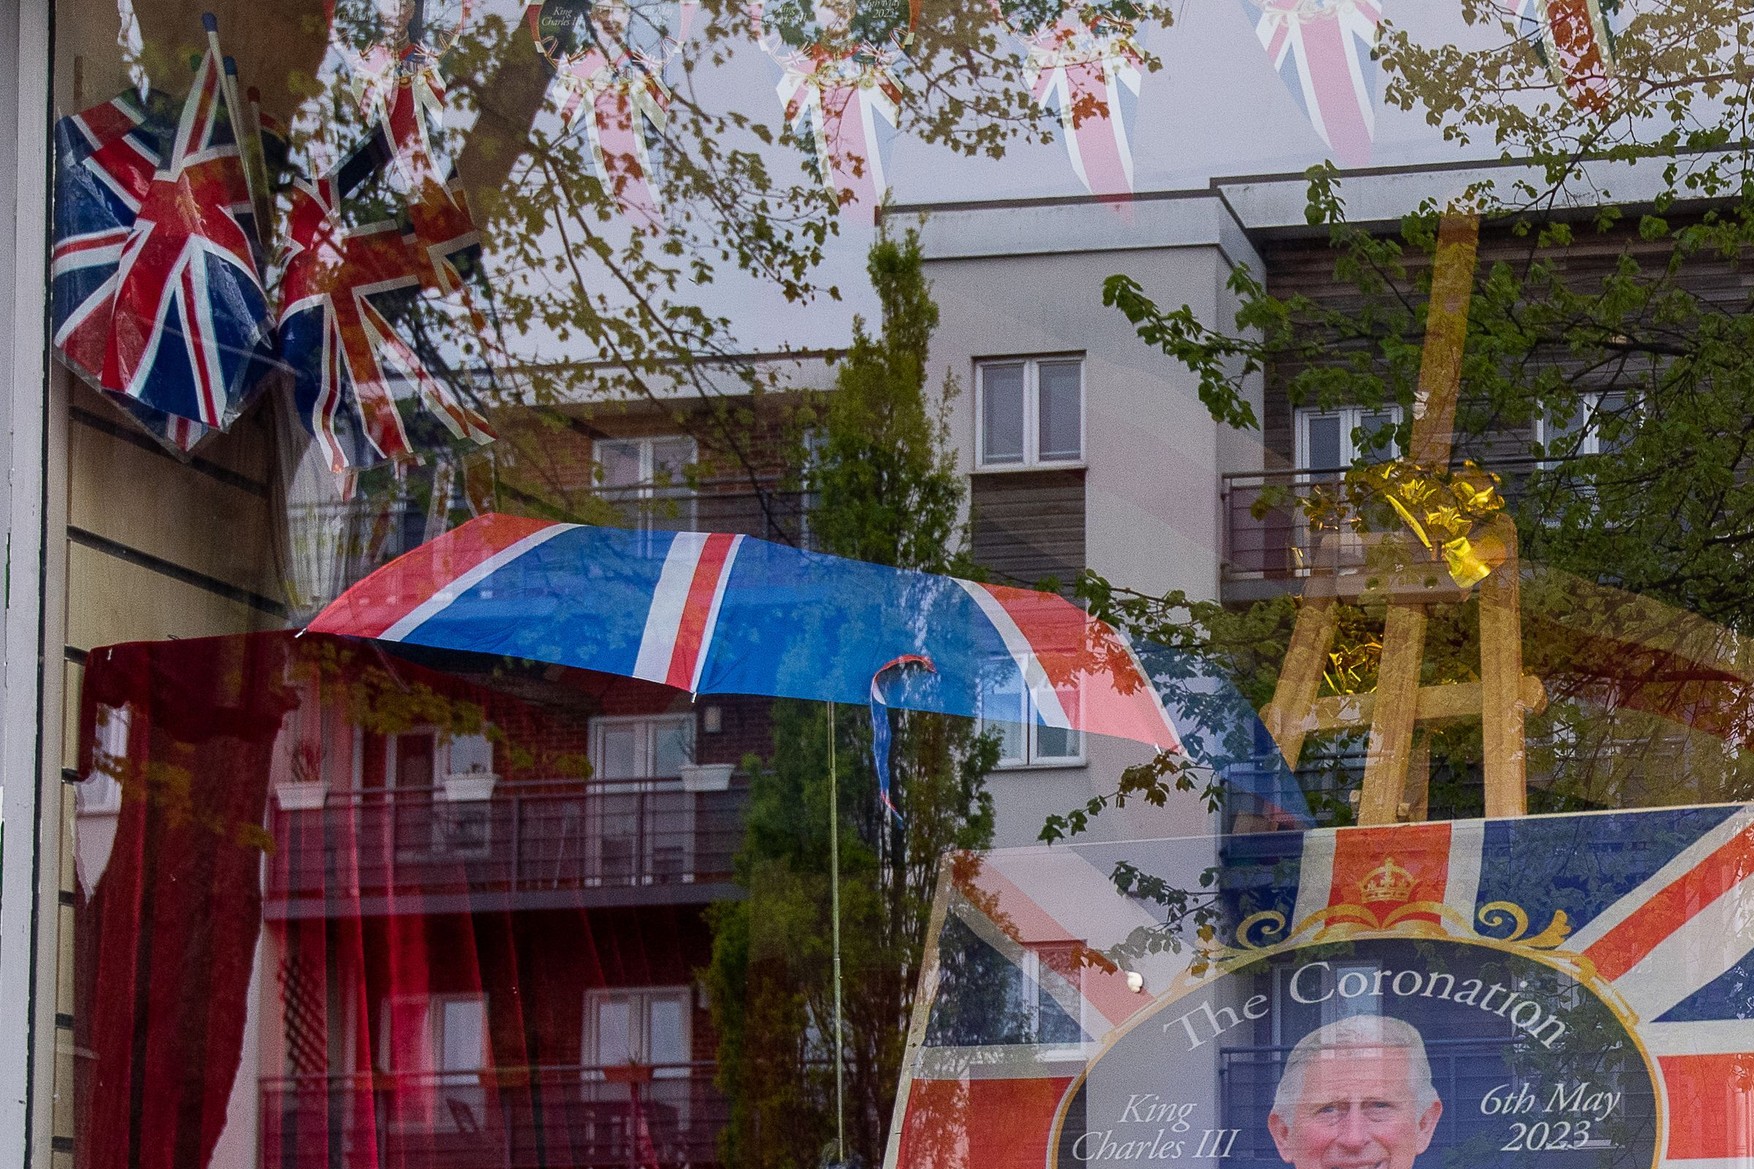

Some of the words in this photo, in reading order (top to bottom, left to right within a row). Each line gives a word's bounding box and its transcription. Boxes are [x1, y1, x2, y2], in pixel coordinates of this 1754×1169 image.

[541, 16, 571, 26] Charles
[552, 6, 573, 17] King
[1163, 993, 1269, 1053] The
[1289, 961, 1570, 1048] Coronation
[1117, 1093, 1198, 1133] King
[1480, 1082, 1536, 1115] 6th
[1541, 1081, 1621, 1122] May
[1072, 1128, 1186, 1161] Charles
[1191, 1128, 1243, 1158] III
[1499, 1120, 1592, 1151] 2023
